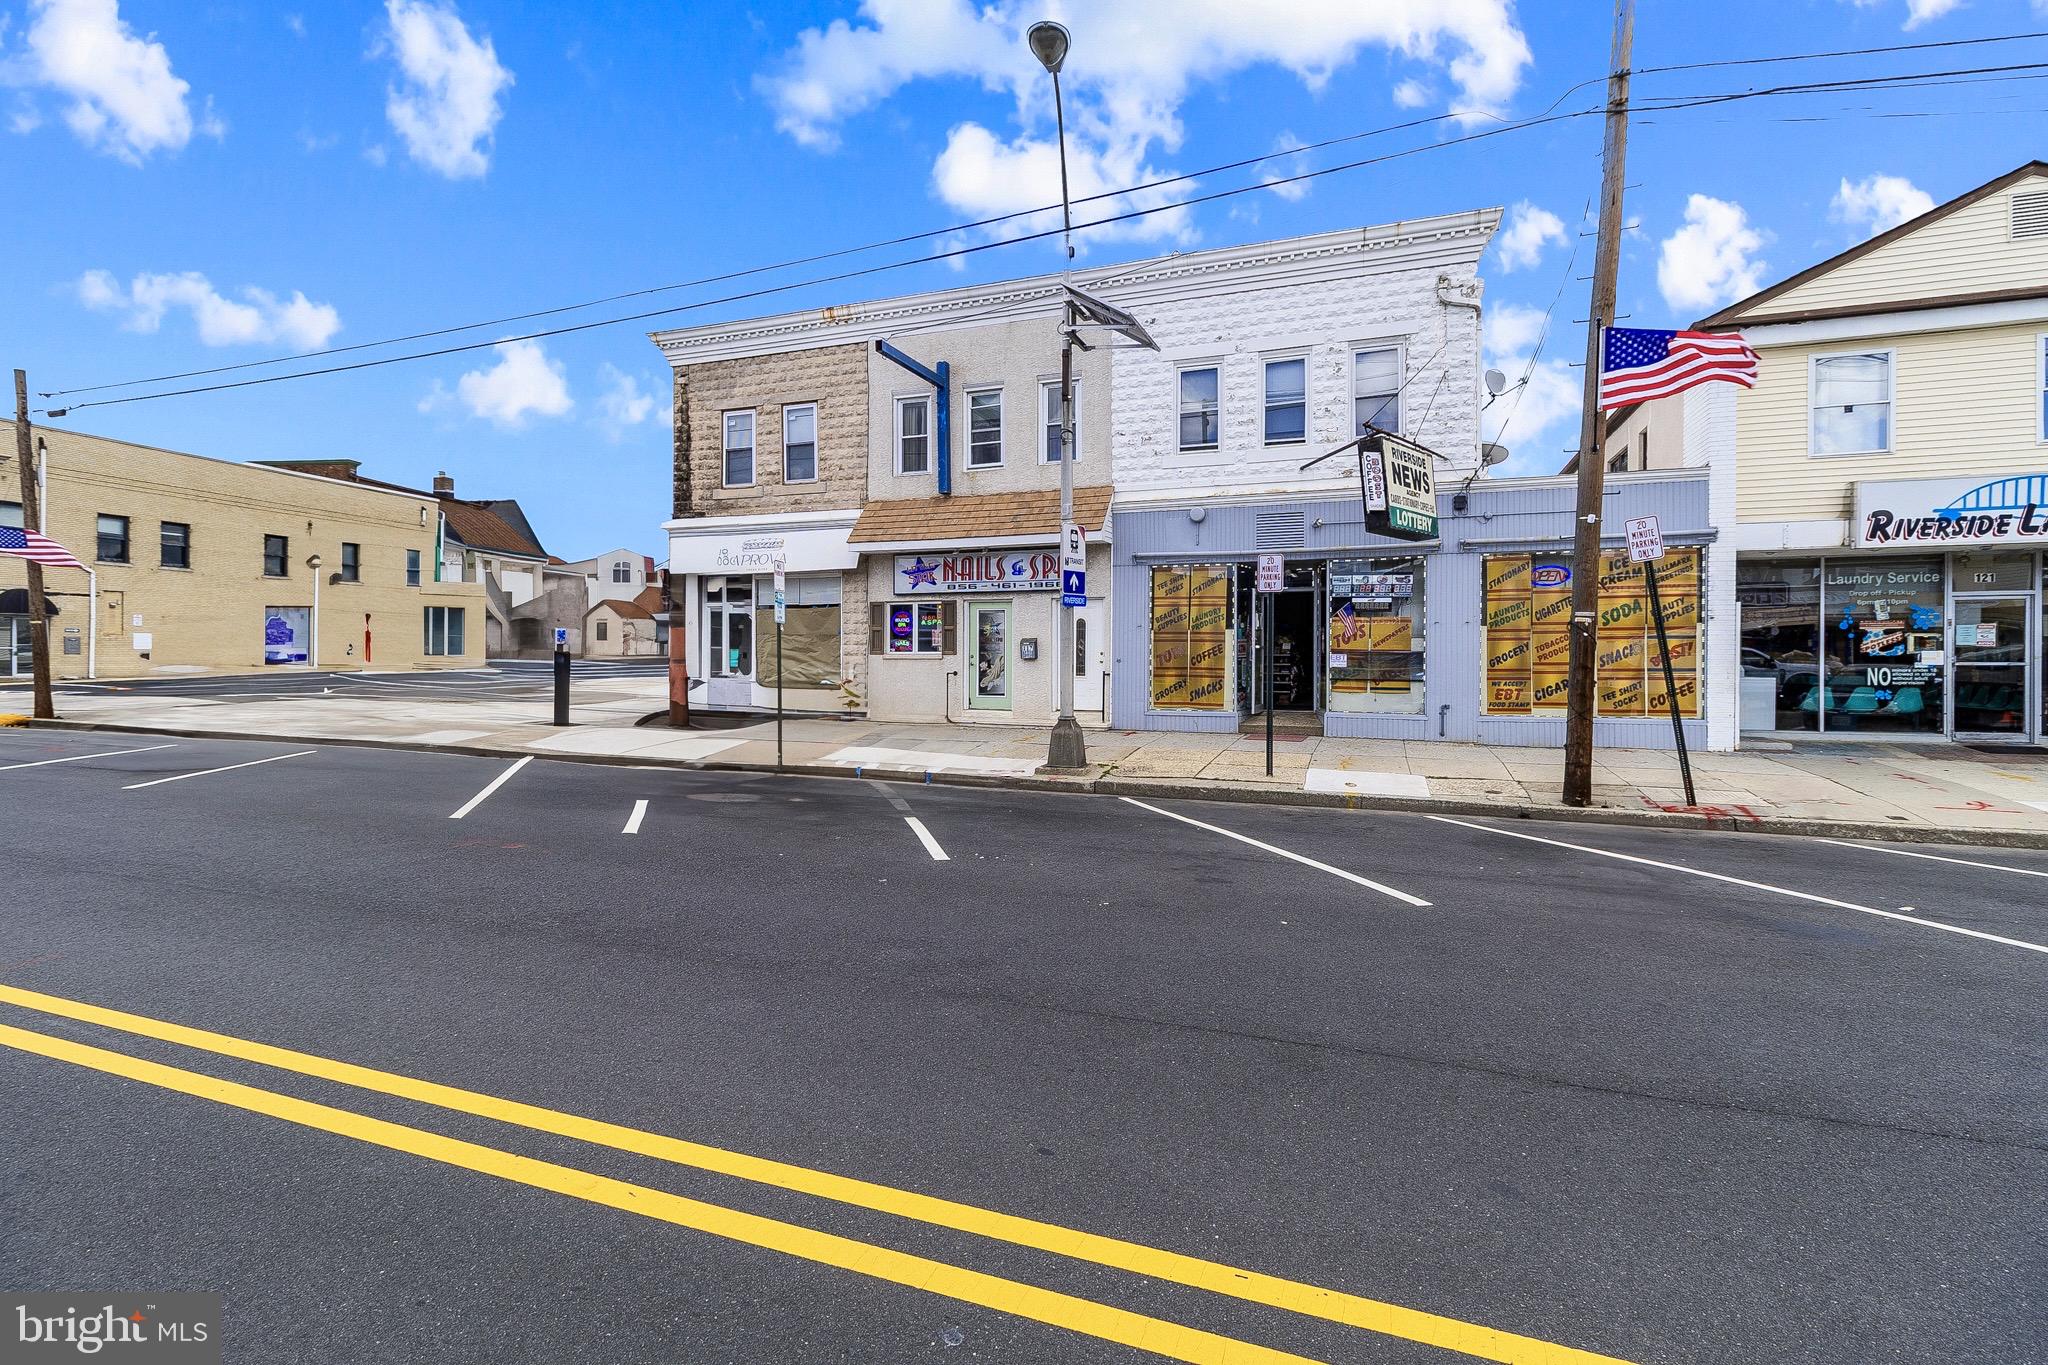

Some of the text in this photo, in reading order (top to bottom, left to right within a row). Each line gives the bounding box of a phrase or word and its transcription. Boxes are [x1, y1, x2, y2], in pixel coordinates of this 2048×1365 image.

[1391, 447, 1427, 469] RIVERSIDE
[1391, 461, 1430, 494] NEWS
[1396, 509, 1432, 532] LOTTERY
[1636, 520, 1647, 530] 20
[1866, 510, 2013, 543] RIVERSIDE
[1631, 528, 1655, 540] MINUTE
[1631, 538, 1659, 550] PARKING
[1637, 548, 1655, 558] ONLY
[942, 555, 1008, 582] NAILS
[1011, 559, 1027, 576] &
[1261, 565, 1279, 573] MINUTE
[1266, 557, 1275, 565] 20
[1608, 557, 1629, 571] ICE
[1653, 555, 1692, 573] ALLMARK
[908, 572, 938, 585] STAR
[1156, 571, 1188, 591] TEE SHIRT
[1260, 573, 1281, 581] PARKING
[1263, 581, 1277, 589] ONLY
[1601, 567, 1642, 585] CREAM
[1828, 571, 1940, 586] Laundry Service
[1975, 573, 1995, 582] 121
[1165, 582, 1184, 596] SOCKS
[1155, 607, 1180, 624] BEAUTY
[1191, 607, 1222, 624] LAUNDRY
[1488, 608, 1530, 629] PRODUCTS
[1489, 601, 1526, 620] LAUNDRY
[1601, 598, 1643, 626] SODA
[1662, 603, 1695, 624] PPLIES
[1157, 612, 1188, 632] SUPPLIES
[1191, 614, 1225, 632] PRODUCTS
[1372, 624, 1410, 648] NEWSPAPERS
[1535, 634, 1569, 653] TOBACCO
[1190, 643, 1224, 666] COFFEE
[1489, 641, 1530, 668] GROCERY
[1537, 644, 1569, 662] PRODUC
[1867, 667, 1891, 686] NO
[1154, 678, 1187, 702] GROCERY
[1189, 679, 1224, 702] SNACKS
[1494, 688, 1523, 701] EBT
[1601, 680, 1643, 702] TEE SHIRT
[1650, 682, 1695, 709] COEE
[1612, 693, 1638, 709] SOCKS
